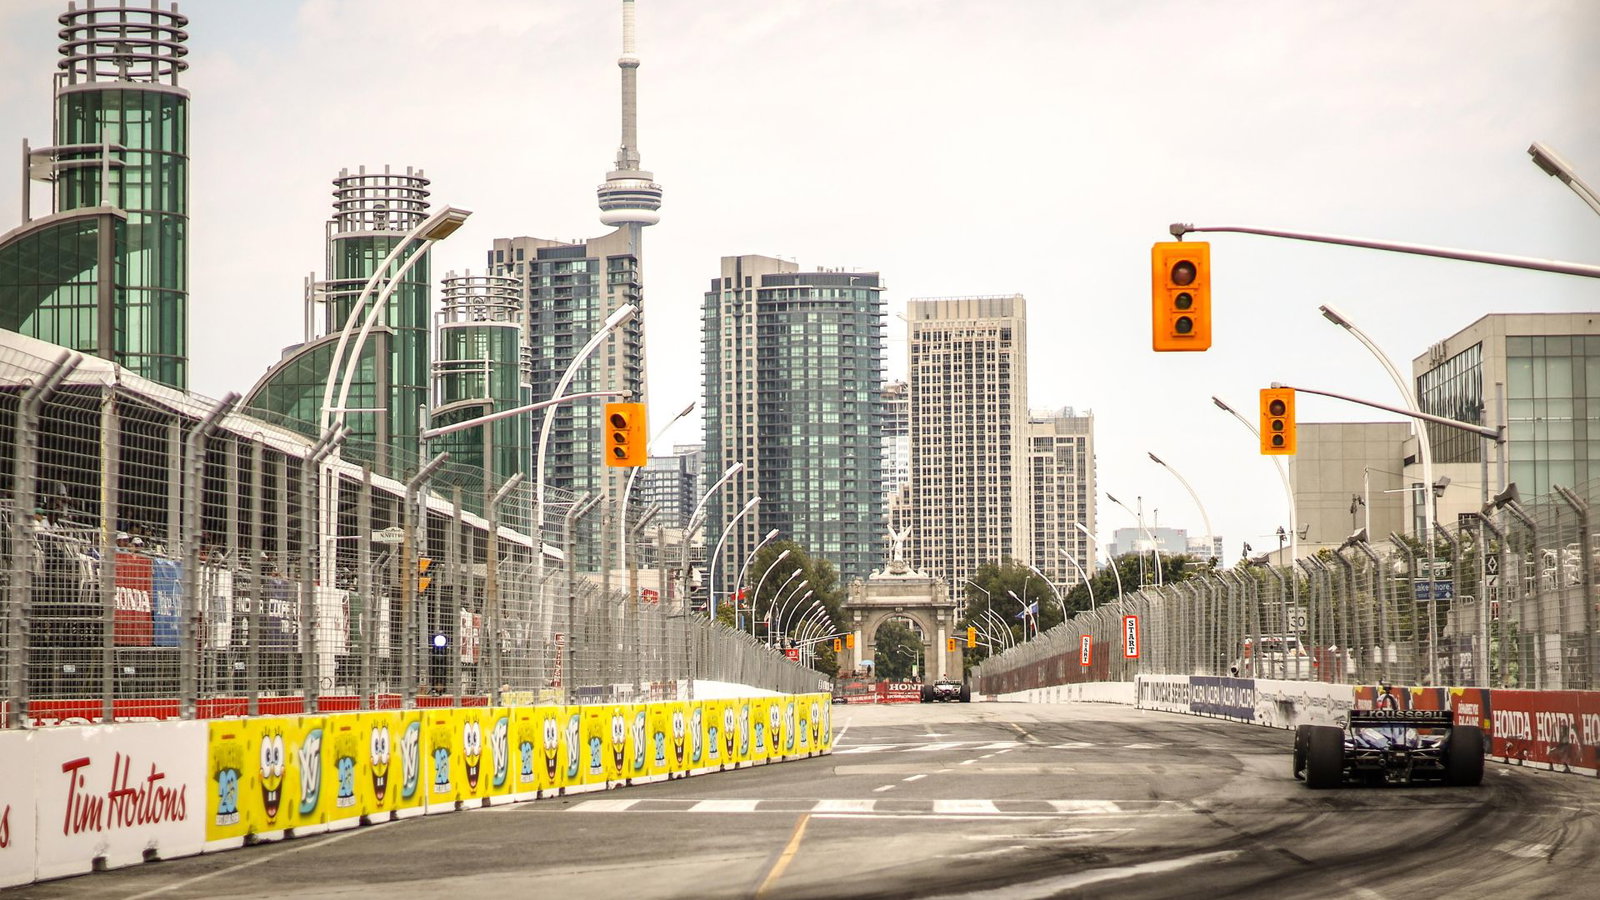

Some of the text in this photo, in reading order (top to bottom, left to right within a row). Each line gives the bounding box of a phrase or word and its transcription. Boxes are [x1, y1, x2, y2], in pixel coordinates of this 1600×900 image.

[1290, 616, 1305, 627] 30
[1369, 710, 1443, 719] rousseau
[1493, 710, 1532, 740] HONDA
[1536, 711, 1577, 744] HONDA
[62, 756, 103, 837] Tim
[108, 751, 187, 830] Hortons
